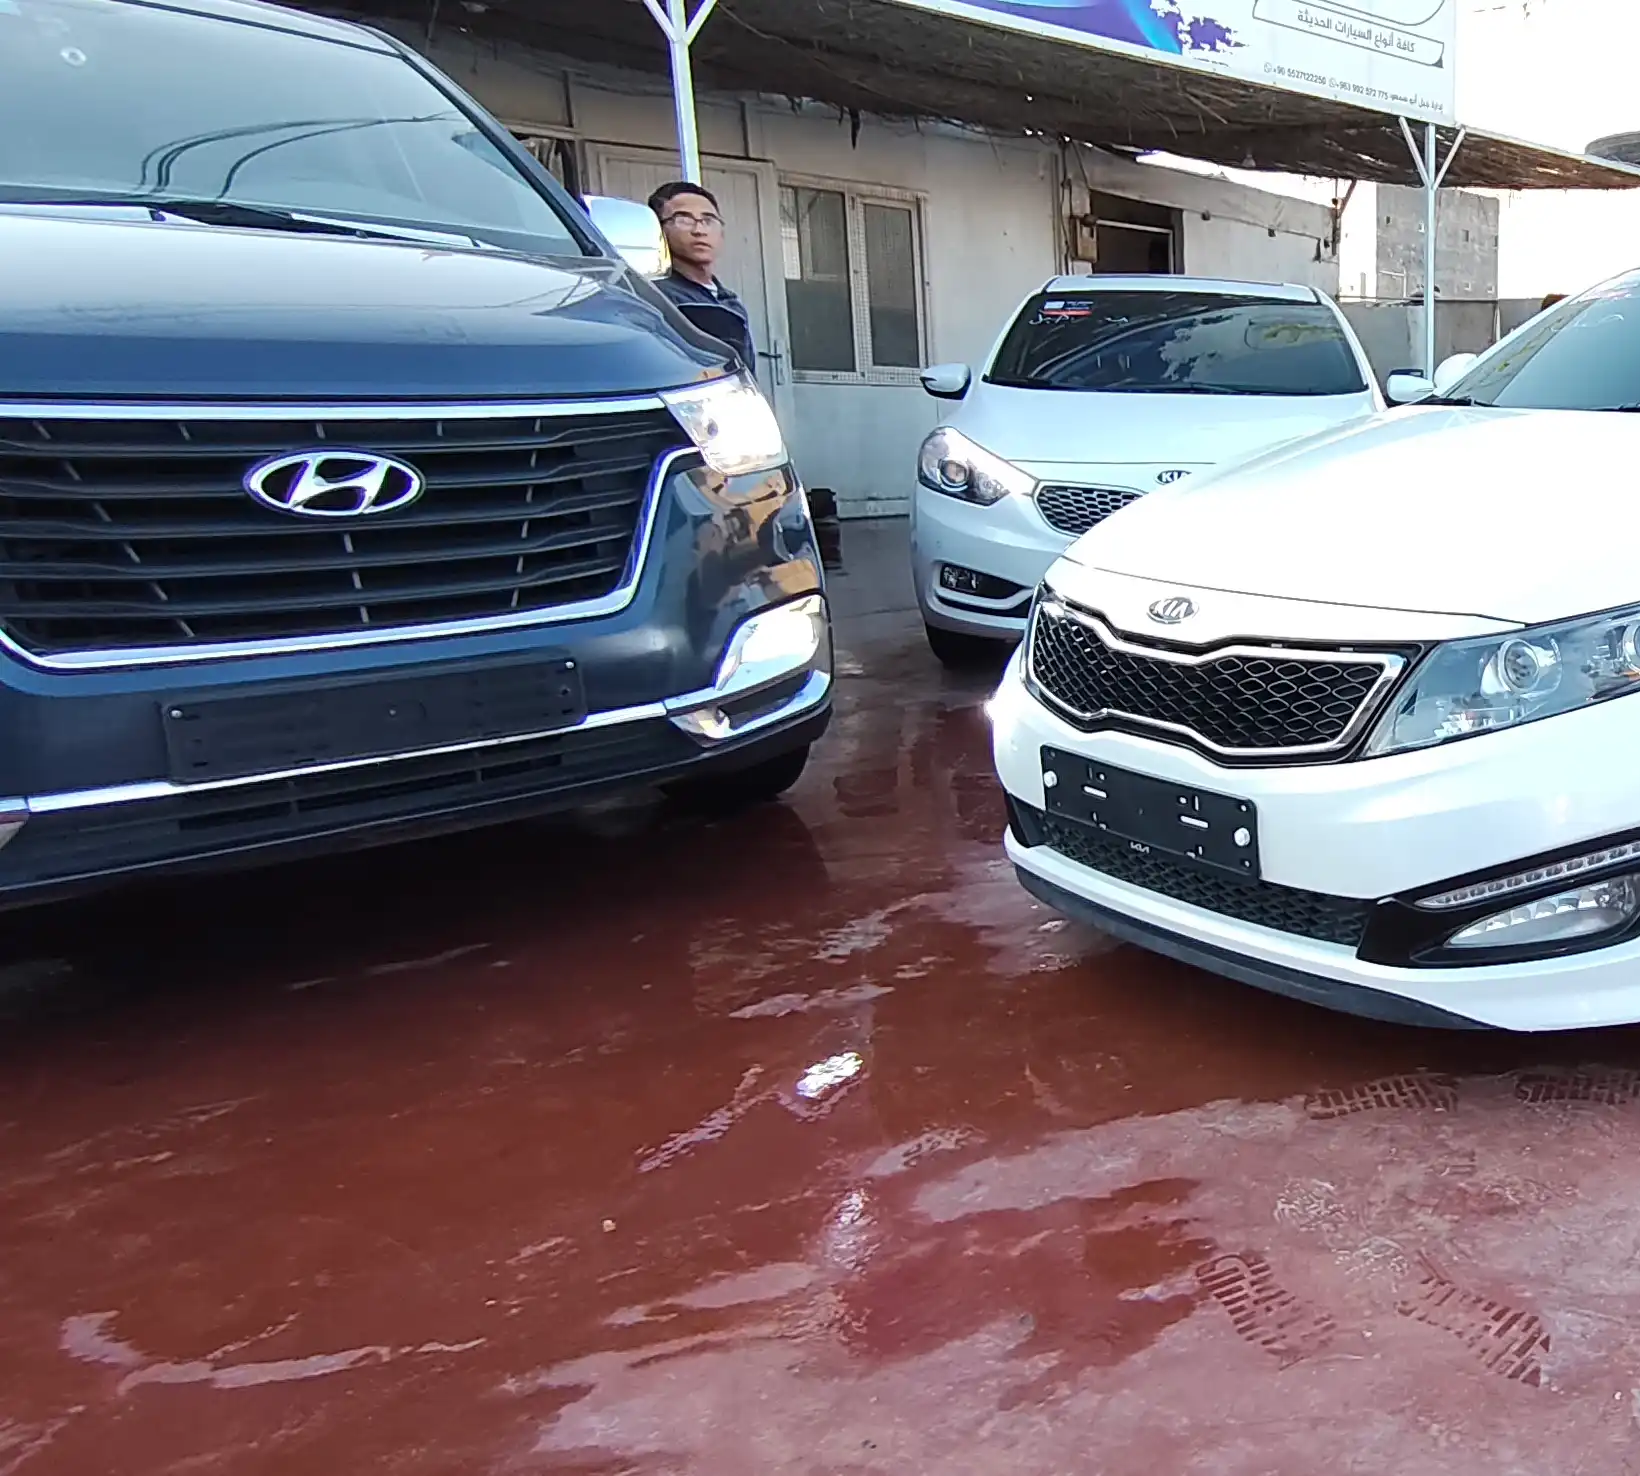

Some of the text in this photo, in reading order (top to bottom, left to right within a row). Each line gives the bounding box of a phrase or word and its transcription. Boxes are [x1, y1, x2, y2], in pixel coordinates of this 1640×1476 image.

[1297, 8, 1416, 52] كافة أنواع السيارات الحديثة
[1154, 599, 1190, 618] KIA
